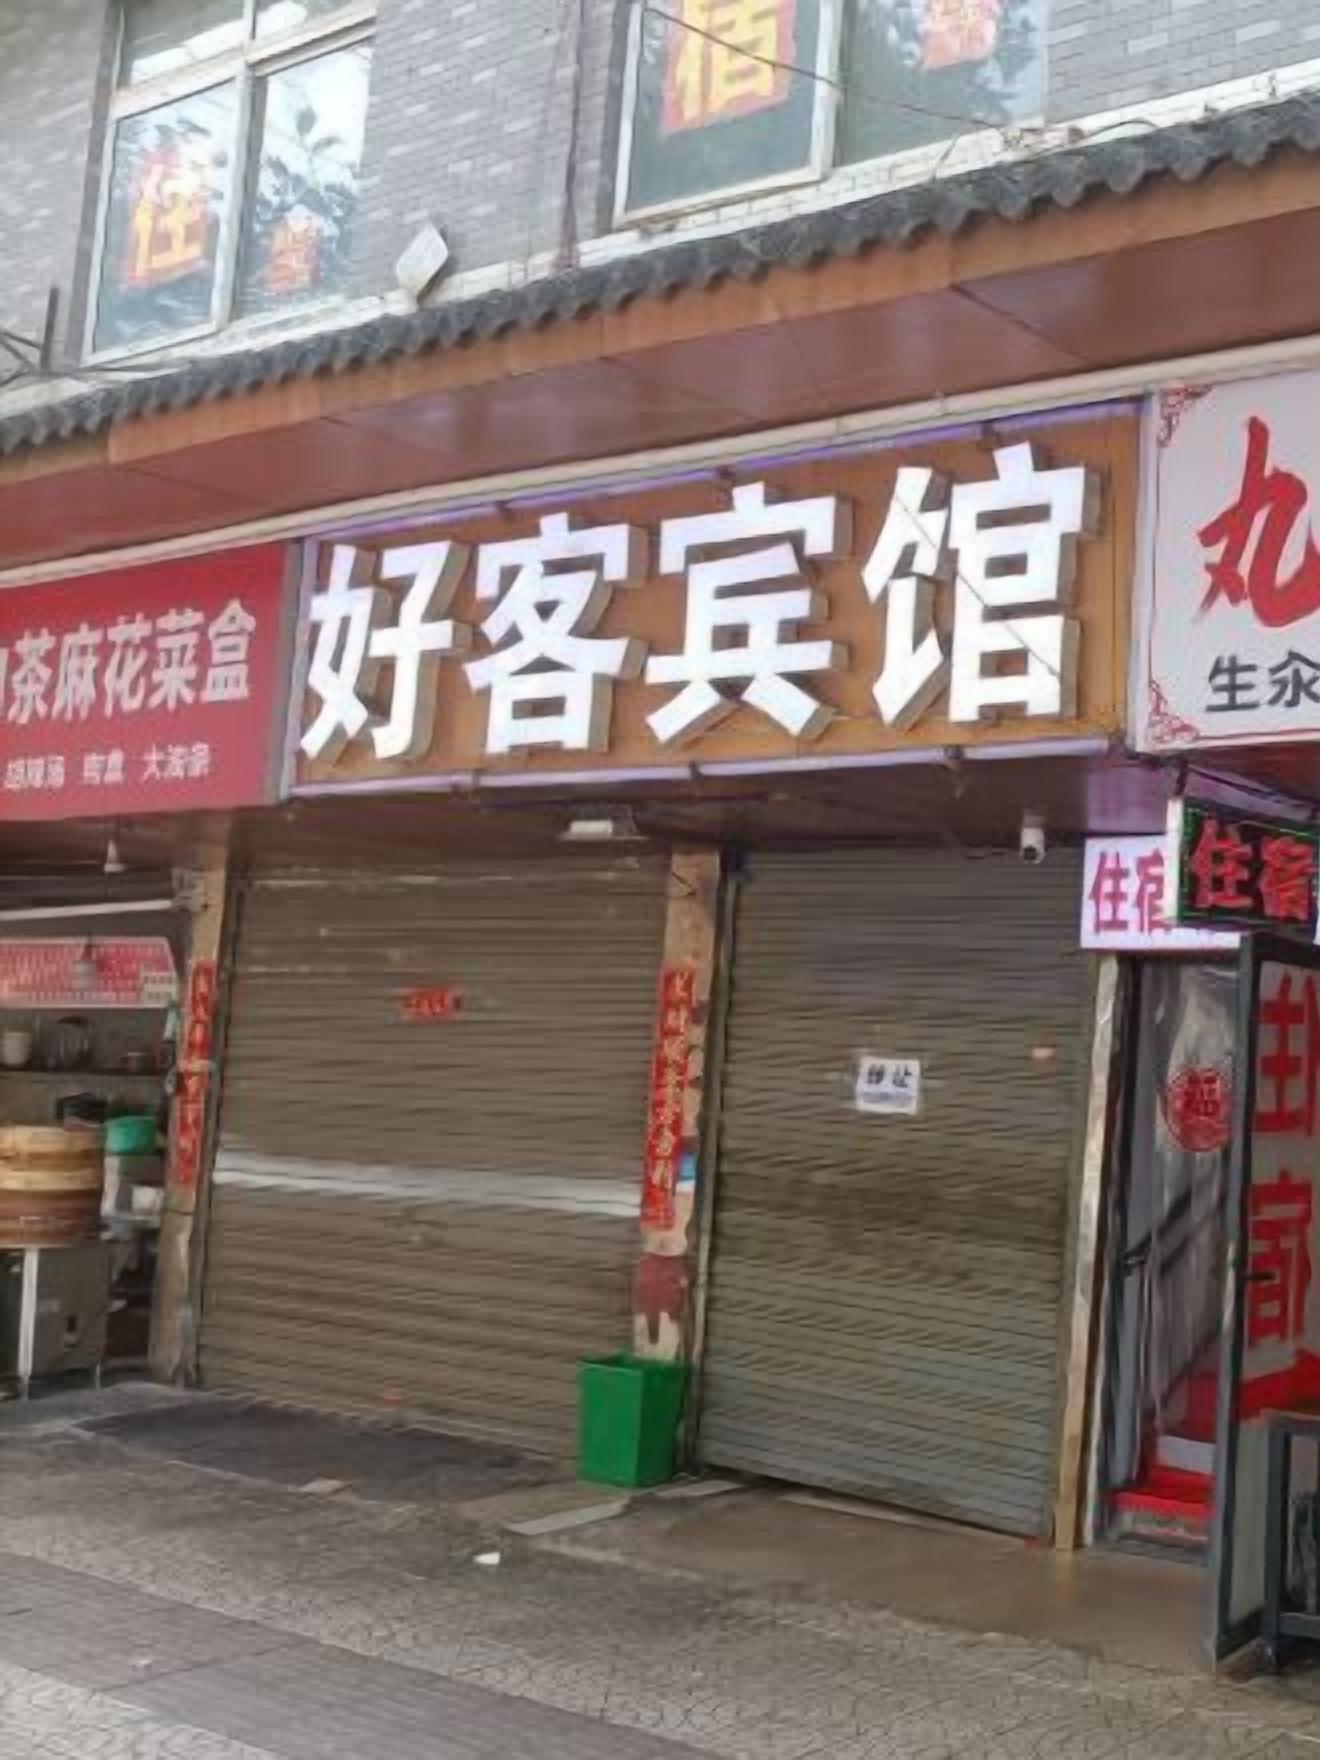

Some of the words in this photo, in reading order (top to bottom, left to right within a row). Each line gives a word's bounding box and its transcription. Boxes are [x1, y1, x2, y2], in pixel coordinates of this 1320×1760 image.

[0, 598, 256, 724] 茶麻花菜盒
[300, 443, 1090, 761] 好客宾馆
